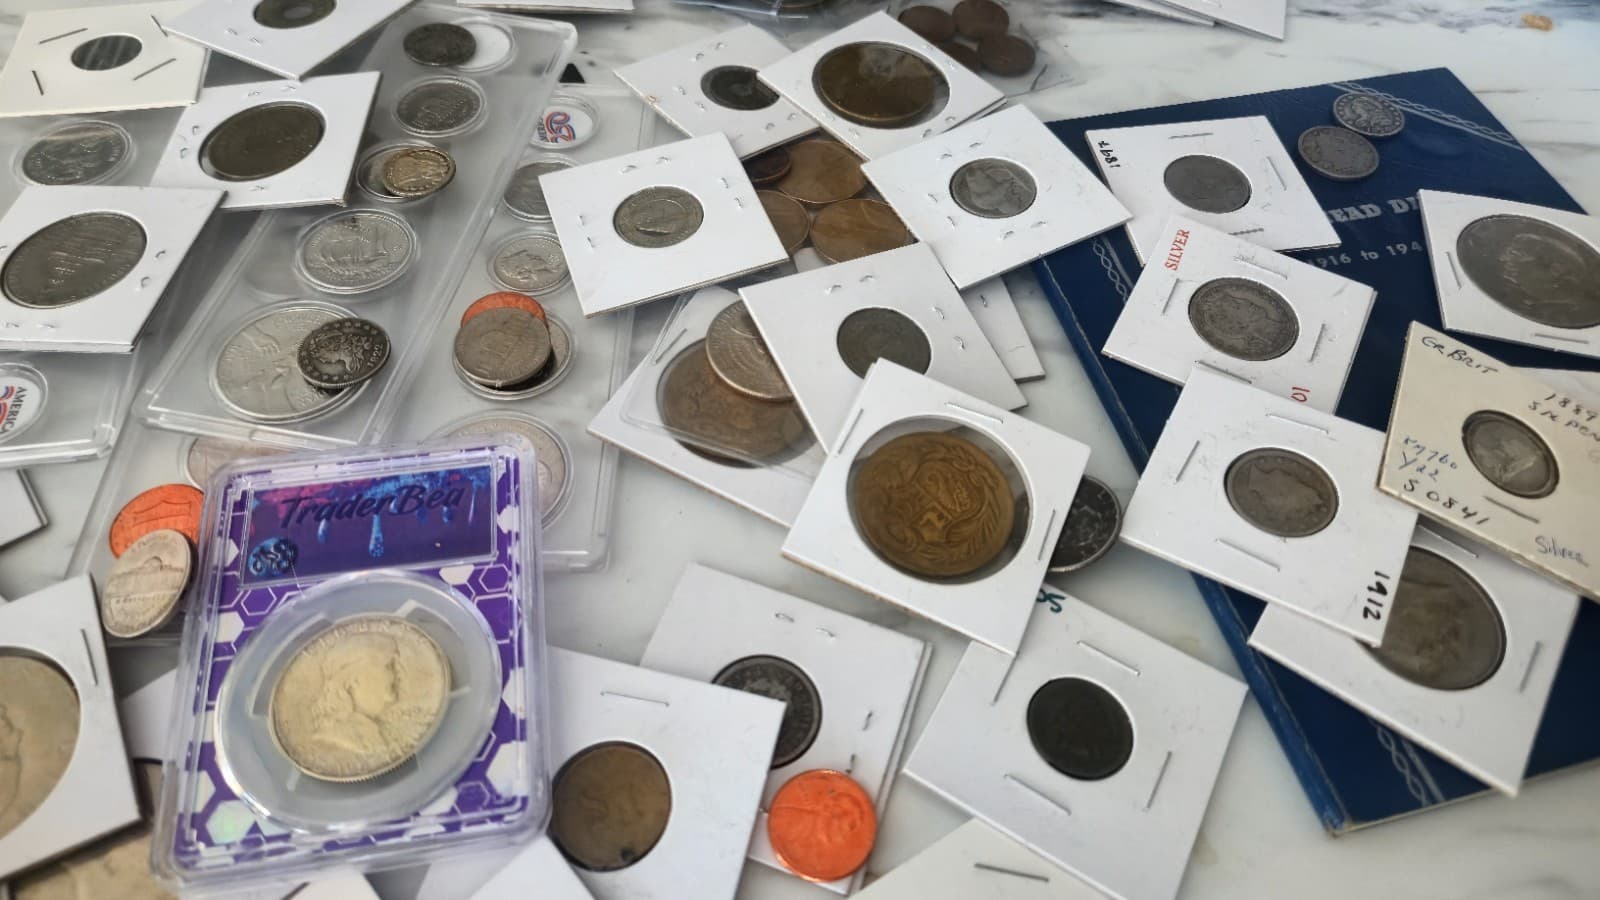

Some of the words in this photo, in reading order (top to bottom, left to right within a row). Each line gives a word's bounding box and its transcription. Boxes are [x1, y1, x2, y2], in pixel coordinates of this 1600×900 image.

[1097, 140, 1121, 168] 1897
[1328, 203, 1382, 224] EAD
[1164, 229, 1190, 271] SILVER
[1360, 249, 1380, 261] to
[280, 484, 467, 529] TraderBea
[1362, 570, 1391, 620] 1912
